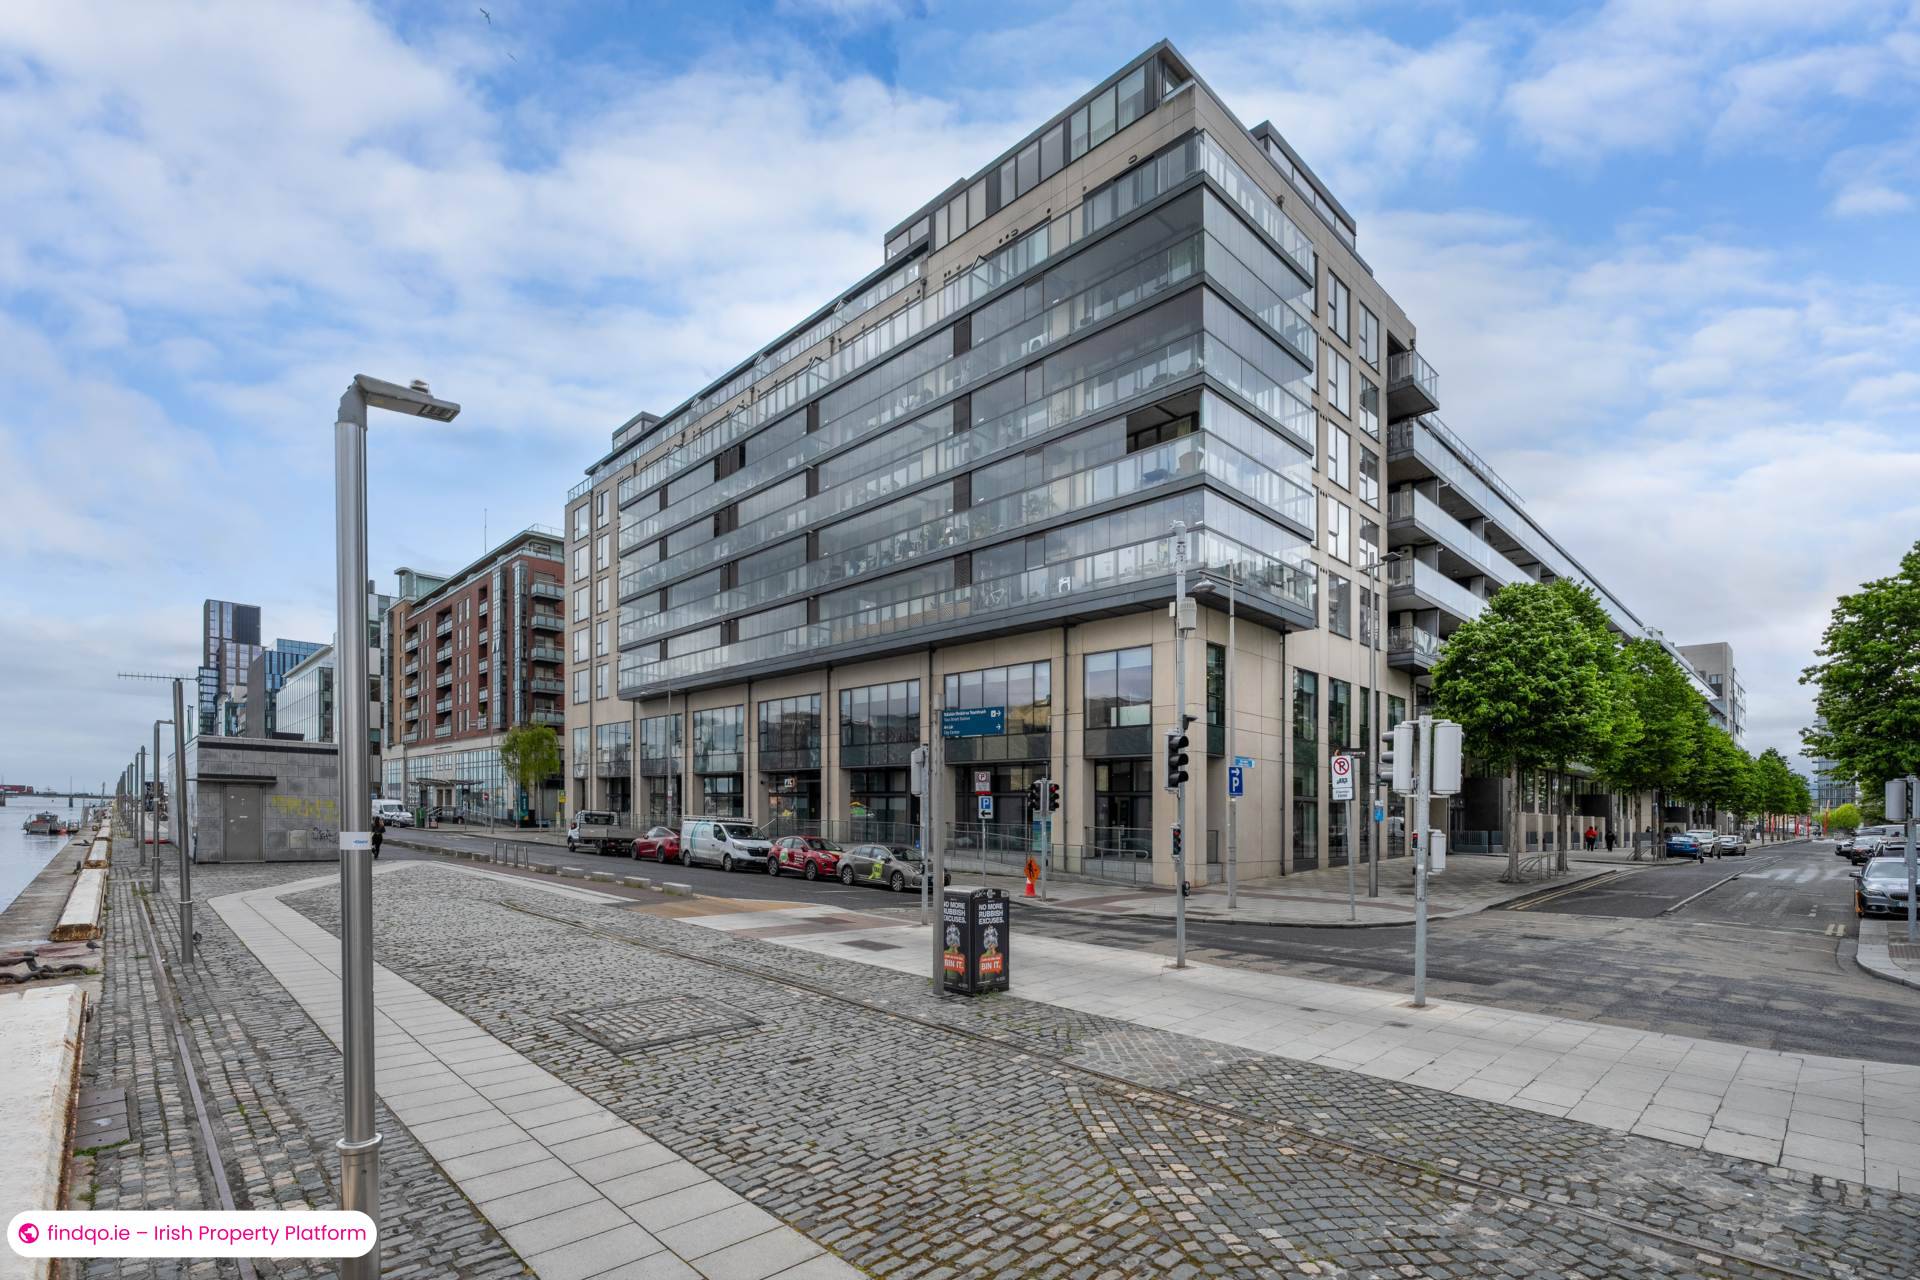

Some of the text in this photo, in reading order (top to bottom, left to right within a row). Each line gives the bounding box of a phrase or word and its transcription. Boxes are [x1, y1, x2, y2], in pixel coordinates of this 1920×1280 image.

[1232, 777, 1240, 792] P
[982, 798, 990, 808] P
[944, 908, 965, 916] UBBISH
